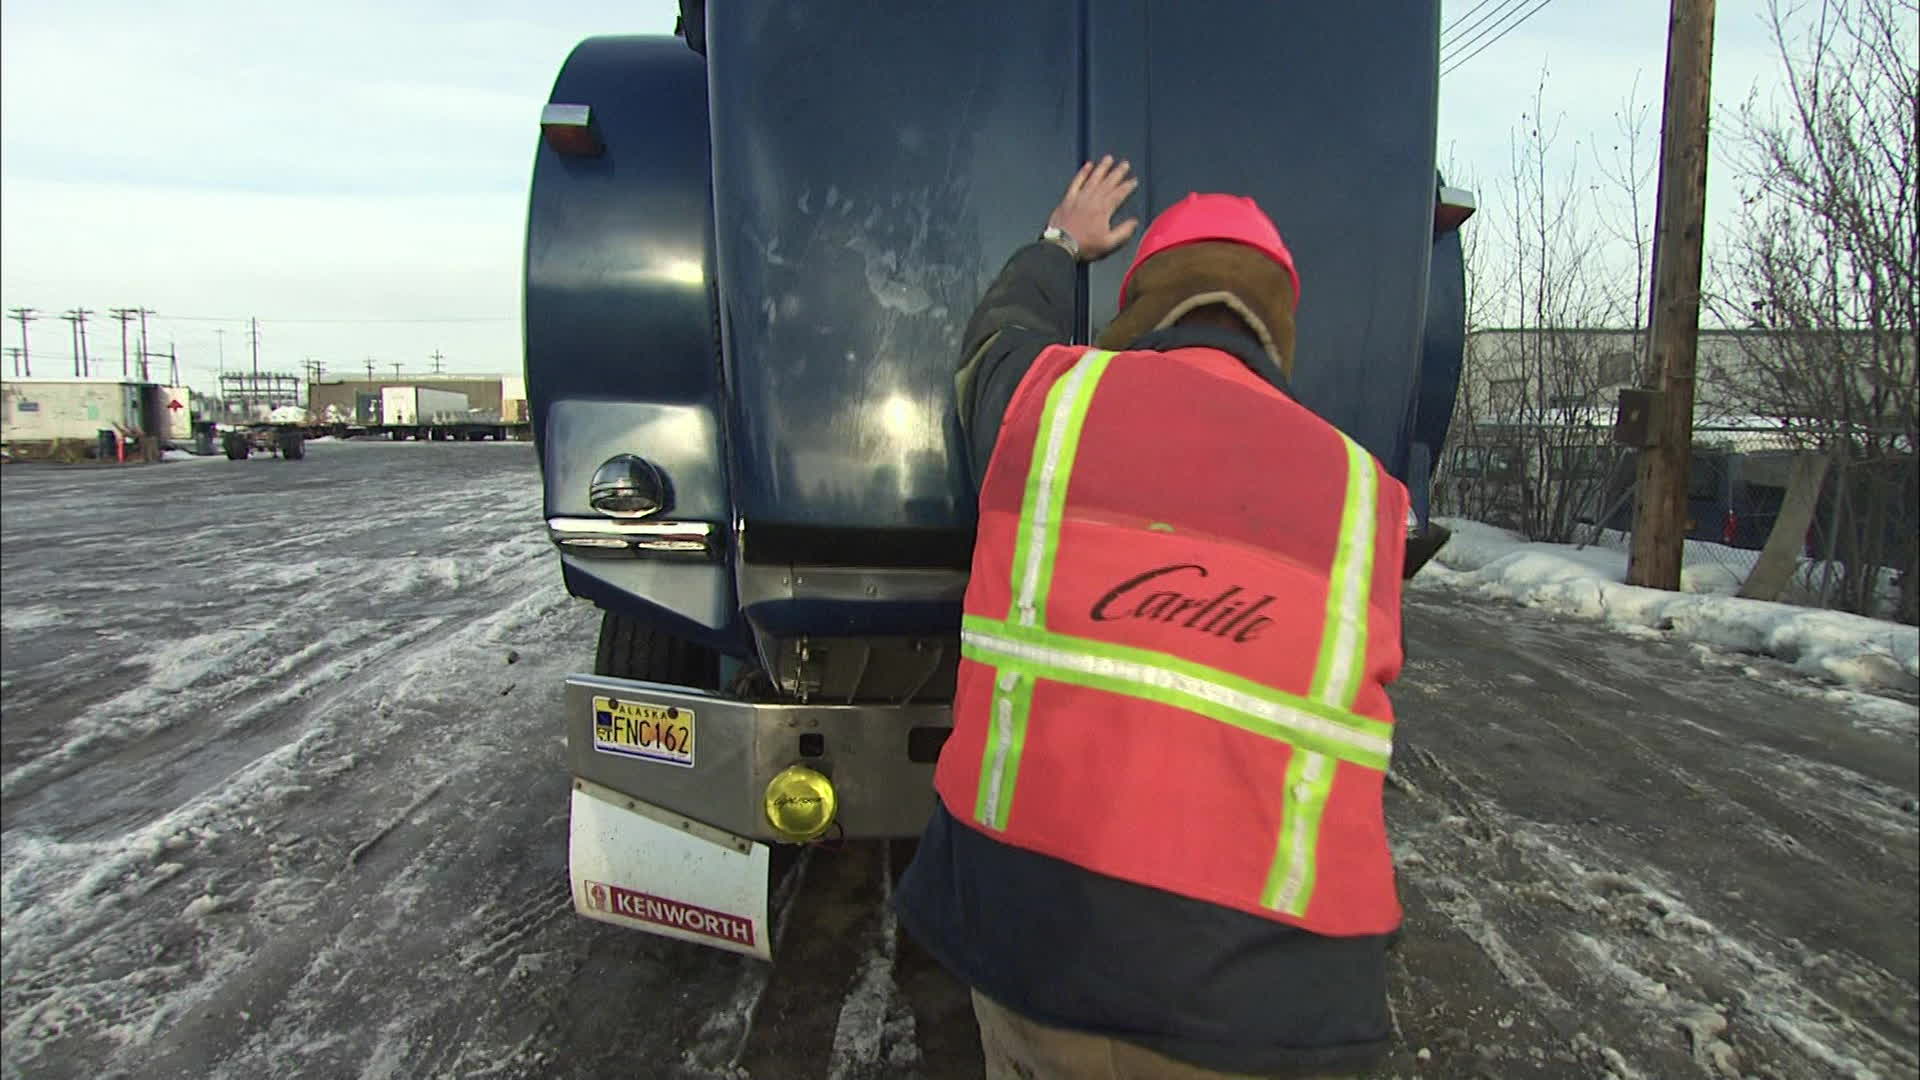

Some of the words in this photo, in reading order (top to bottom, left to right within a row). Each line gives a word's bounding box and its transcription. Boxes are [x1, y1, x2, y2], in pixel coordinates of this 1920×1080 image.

[1091, 564, 1276, 643] Carlile
[619, 705, 667, 720] ALASKA
[614, 716, 689, 754] FNC162
[617, 893, 749, 941] KENWORTH
